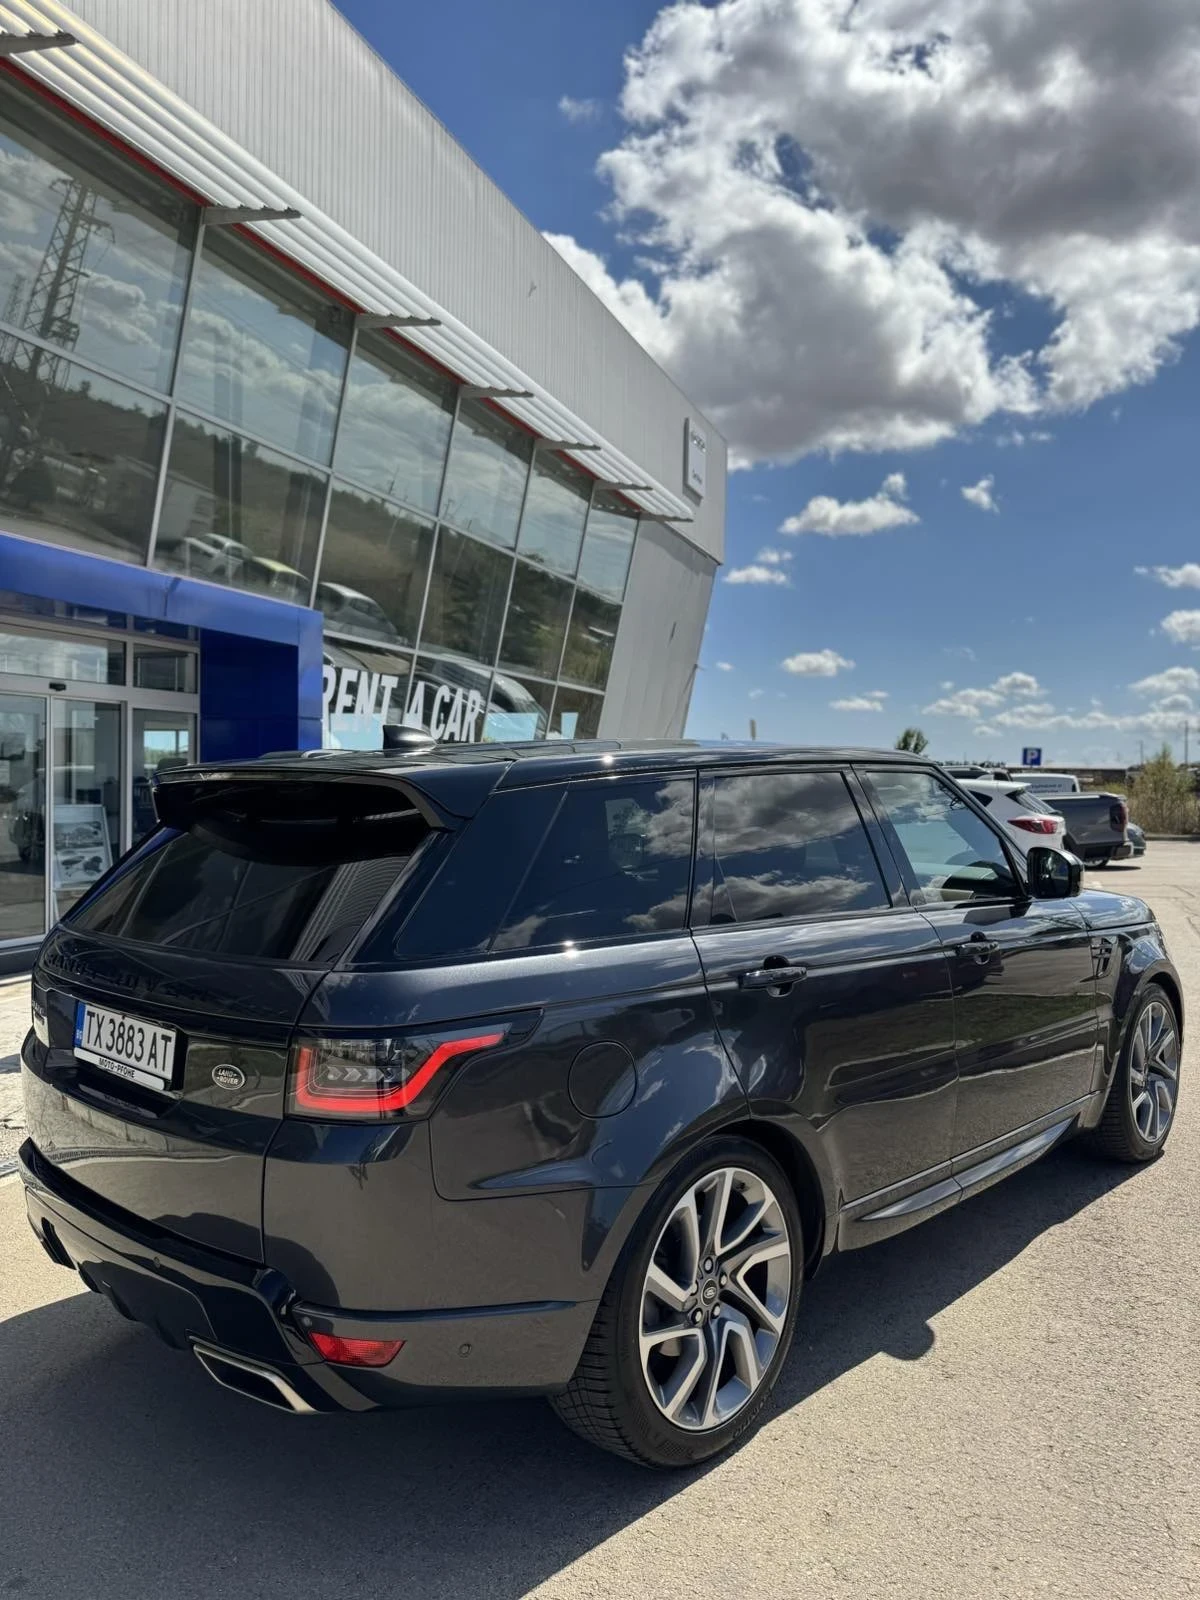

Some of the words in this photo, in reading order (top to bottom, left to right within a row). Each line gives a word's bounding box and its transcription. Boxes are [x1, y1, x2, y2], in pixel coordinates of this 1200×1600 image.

[322, 664, 399, 733] RENT
[402, 680, 425, 729] A
[430, 684, 481, 743] CAR
[86, 1010, 105, 1048] TX
[105, 1018, 145, 1063] 3883
[147, 1031, 172, 1072] AT
[99, 1057, 135, 1079] MOTO-PFOHE
